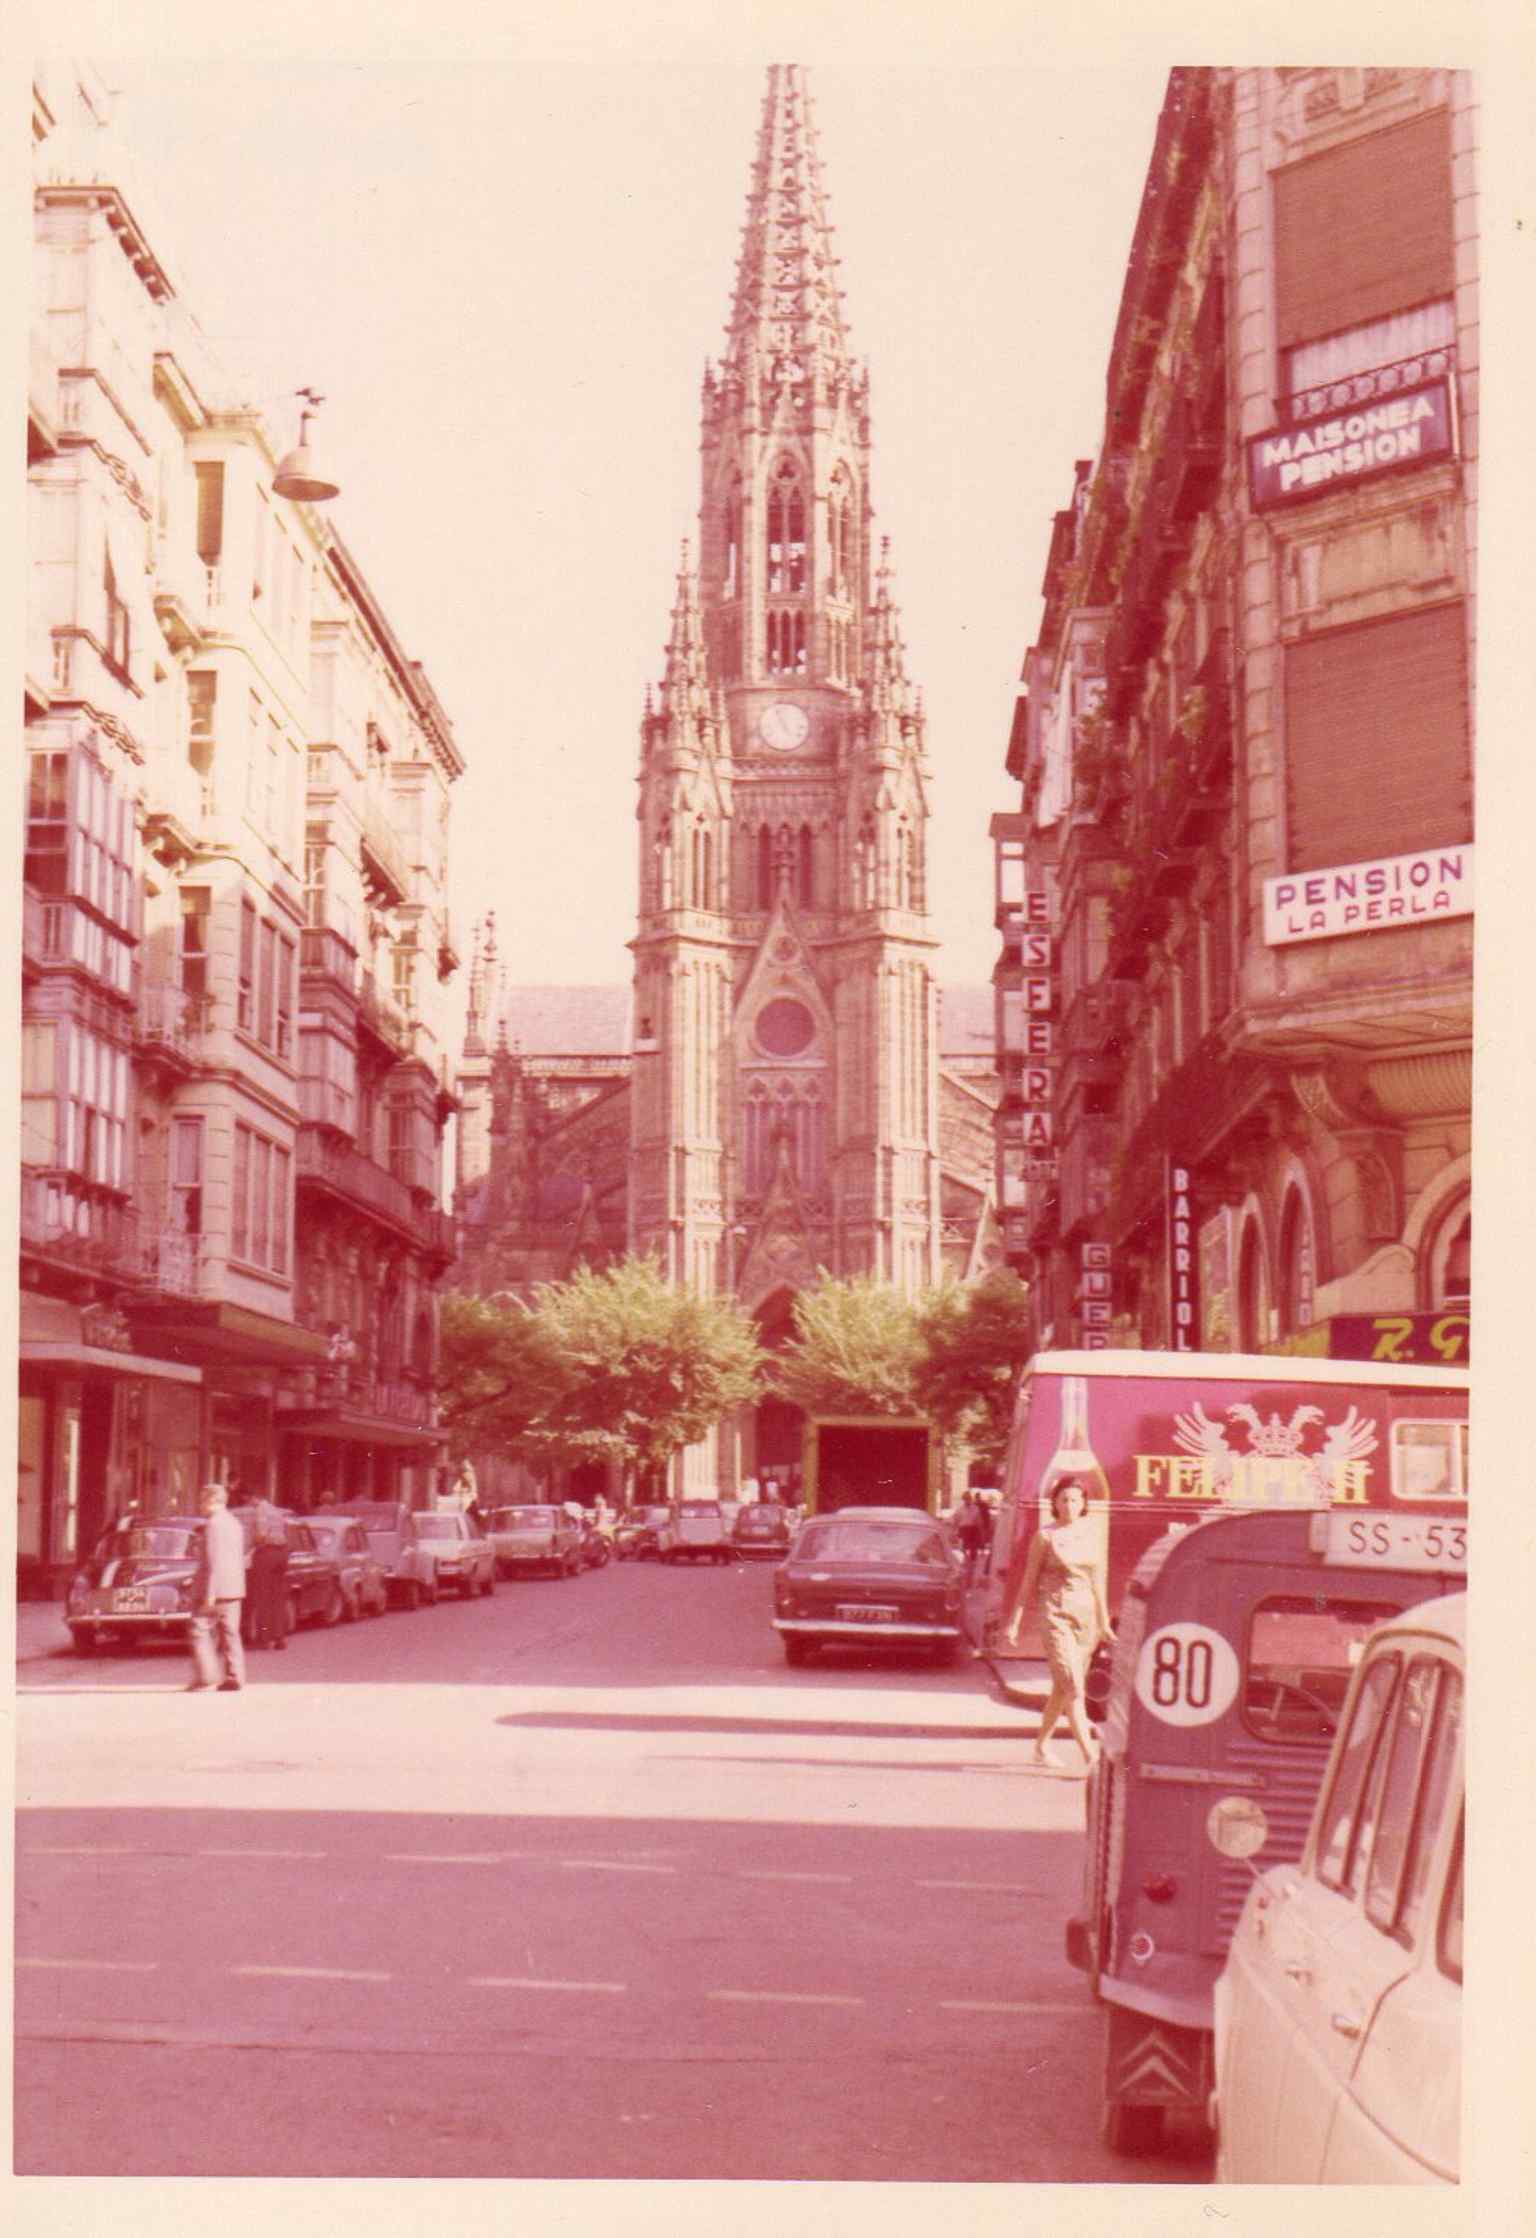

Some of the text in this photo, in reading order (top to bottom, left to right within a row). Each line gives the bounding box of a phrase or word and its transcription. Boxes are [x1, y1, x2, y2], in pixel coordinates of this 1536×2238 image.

[1263, 397, 1435, 467] MAISONEA
[1280, 427, 1421, 492] PENSION
[1275, 855, 1463, 911] PENSION
[1288, 890, 1450, 934] LA PERLA
[1027, 892, 1048, 1145] ESFERA
[1174, 1168, 1192, 1351] BARRIOL
[1153, 1637, 1213, 1708] 80
